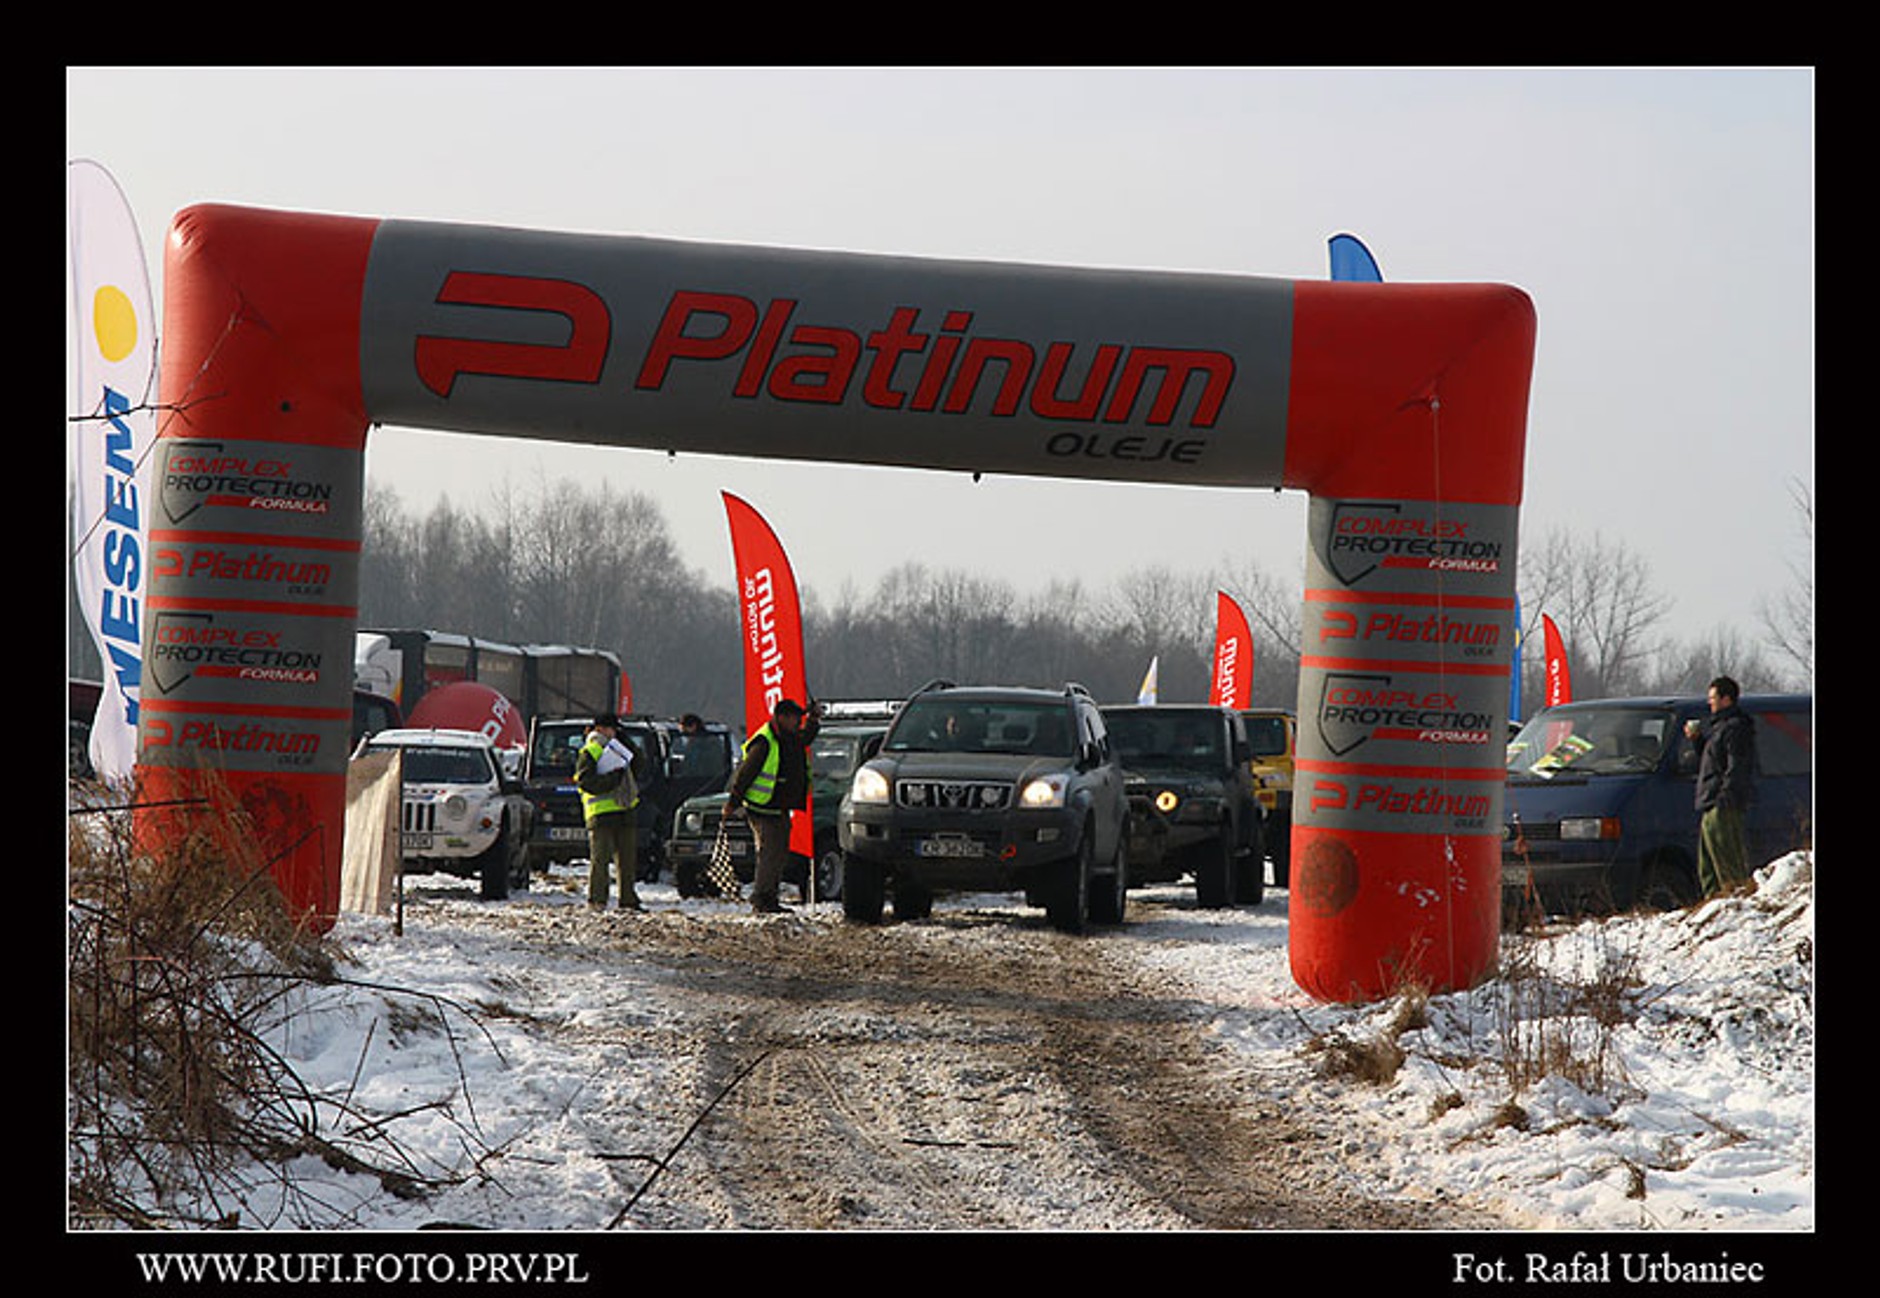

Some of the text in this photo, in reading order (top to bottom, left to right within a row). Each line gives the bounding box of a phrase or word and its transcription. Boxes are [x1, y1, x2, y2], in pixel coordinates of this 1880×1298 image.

[635, 290, 1238, 427] Platinum
[1046, 432, 1206, 464] OLEJE
[167, 456, 293, 478] COMPLEX
[165, 475, 332, 499] PROTECTION
[250, 497, 327, 513] FORMULA
[1335, 516, 1468, 538] COMPLEX
[102, 385, 141, 725] WESEM
[1333, 536, 1500, 558] PROTECTION
[188, 551, 331, 585] Platinum
[1428, 557, 1498, 572] FORMULA
[157, 626, 283, 648] COMPLEX
[1363, 613, 1500, 645] Platinum
[155, 644, 321, 668] PROTECTION
[239, 667, 317, 683] FORMULA
[1326, 687, 1461, 710] COMPLEX
[1324, 706, 1493, 729] PROTECTION
[178, 721, 320, 754] Platinum
[1418, 730, 1488, 742] FORMULA
[1353, 783, 1491, 816] Platinum
